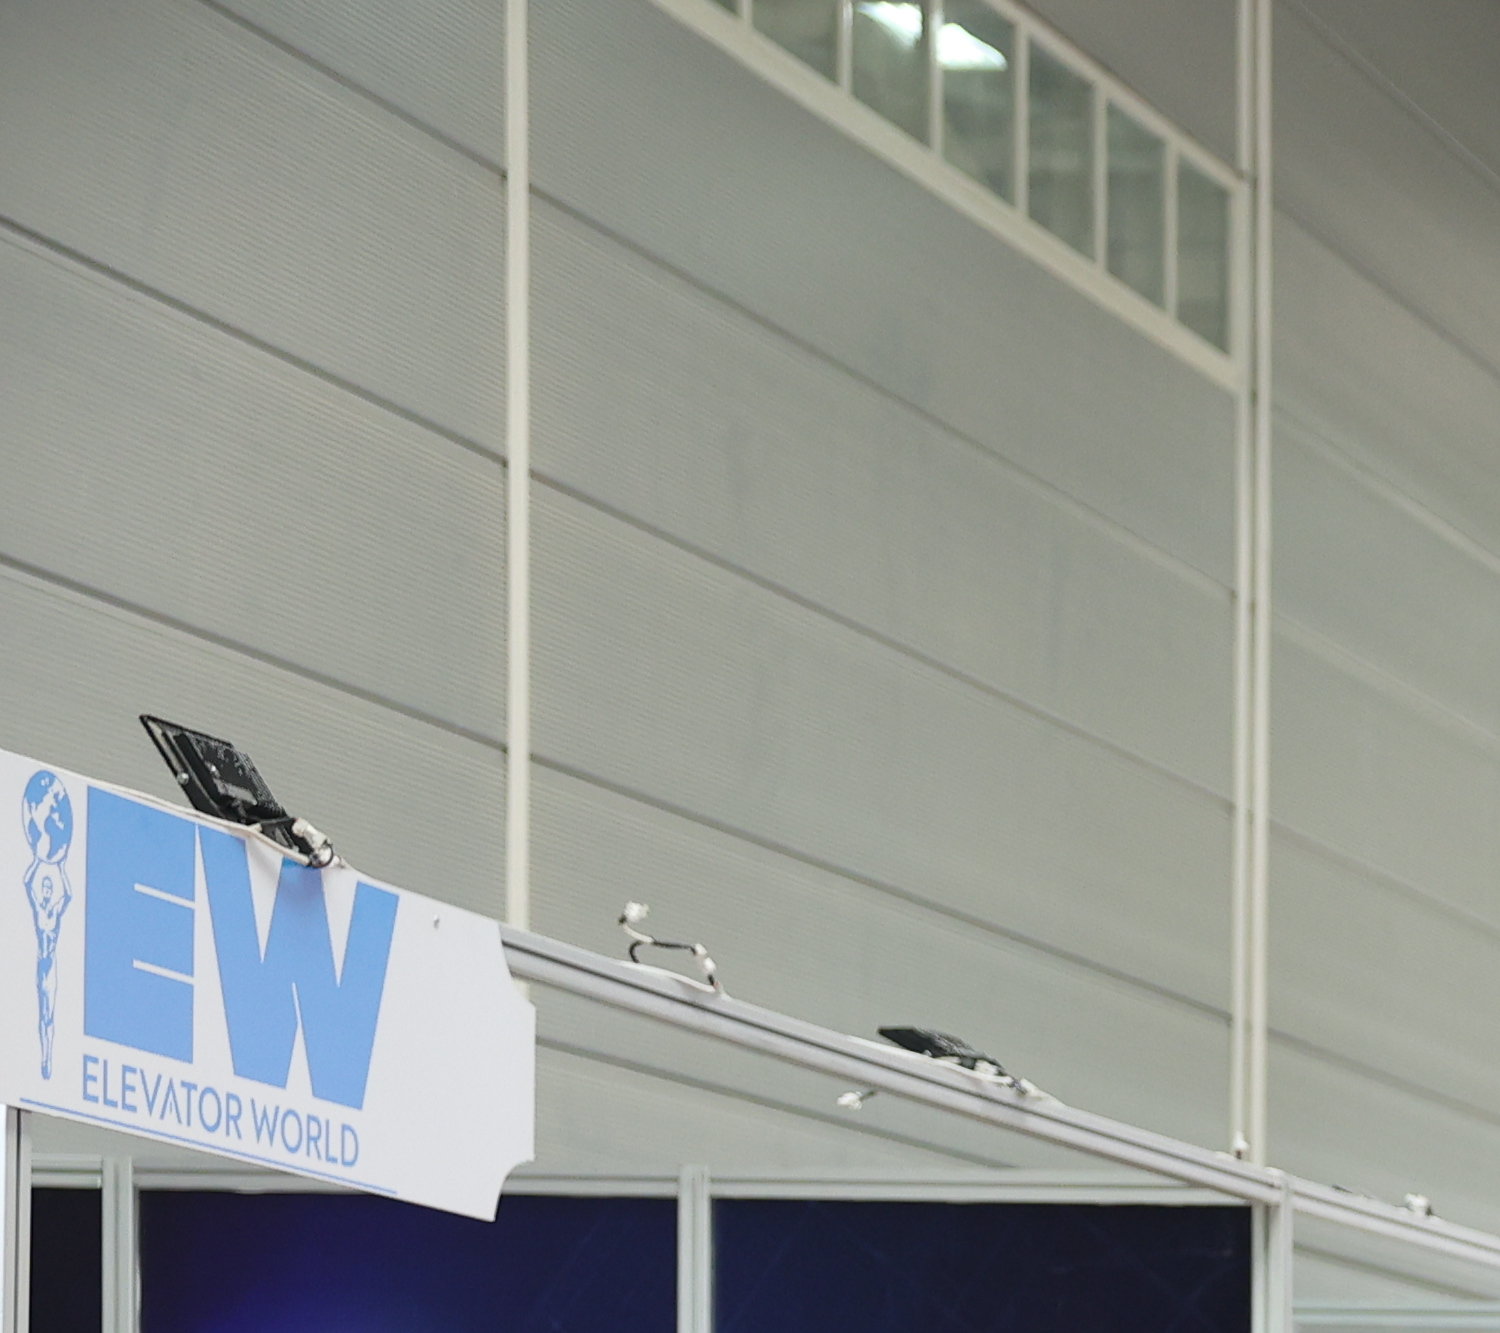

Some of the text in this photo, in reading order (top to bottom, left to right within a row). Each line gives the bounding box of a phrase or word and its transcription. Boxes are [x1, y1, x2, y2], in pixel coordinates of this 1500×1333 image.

[84, 784, 400, 1110] EW
[82, 1054, 359, 1168] ELEVATOR WORLD
